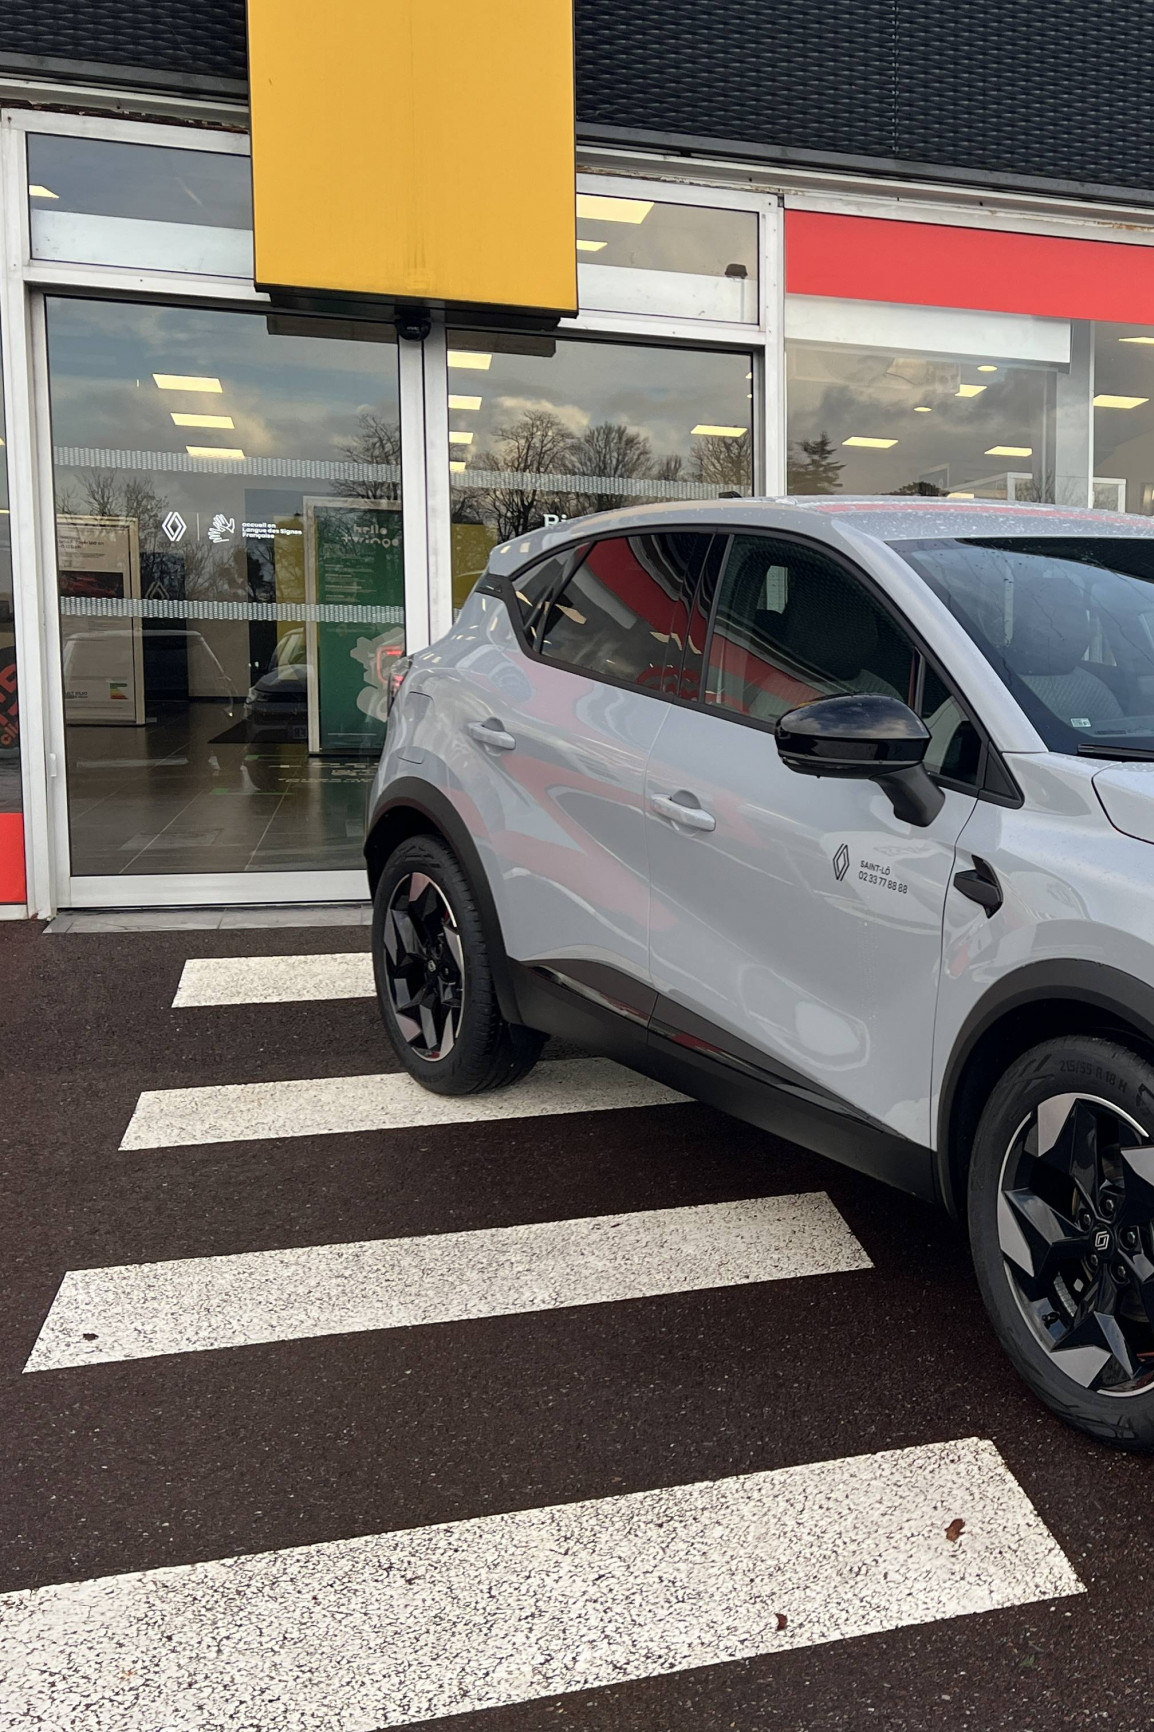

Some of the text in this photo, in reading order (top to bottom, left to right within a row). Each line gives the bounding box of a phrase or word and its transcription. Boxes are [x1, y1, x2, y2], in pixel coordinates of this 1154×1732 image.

[353, 523, 388, 535] hello
[341, 534, 399, 549] twingo
[860, 860, 891, 876] SAINT-LÔ
[858, 870, 868, 881] 02
[868, 873, 878, 885] 33
[878, 876, 888, 887] 77
[1059, 1059, 1093, 1075] 215/55
[1105, 1070, 1117, 1086] 18
